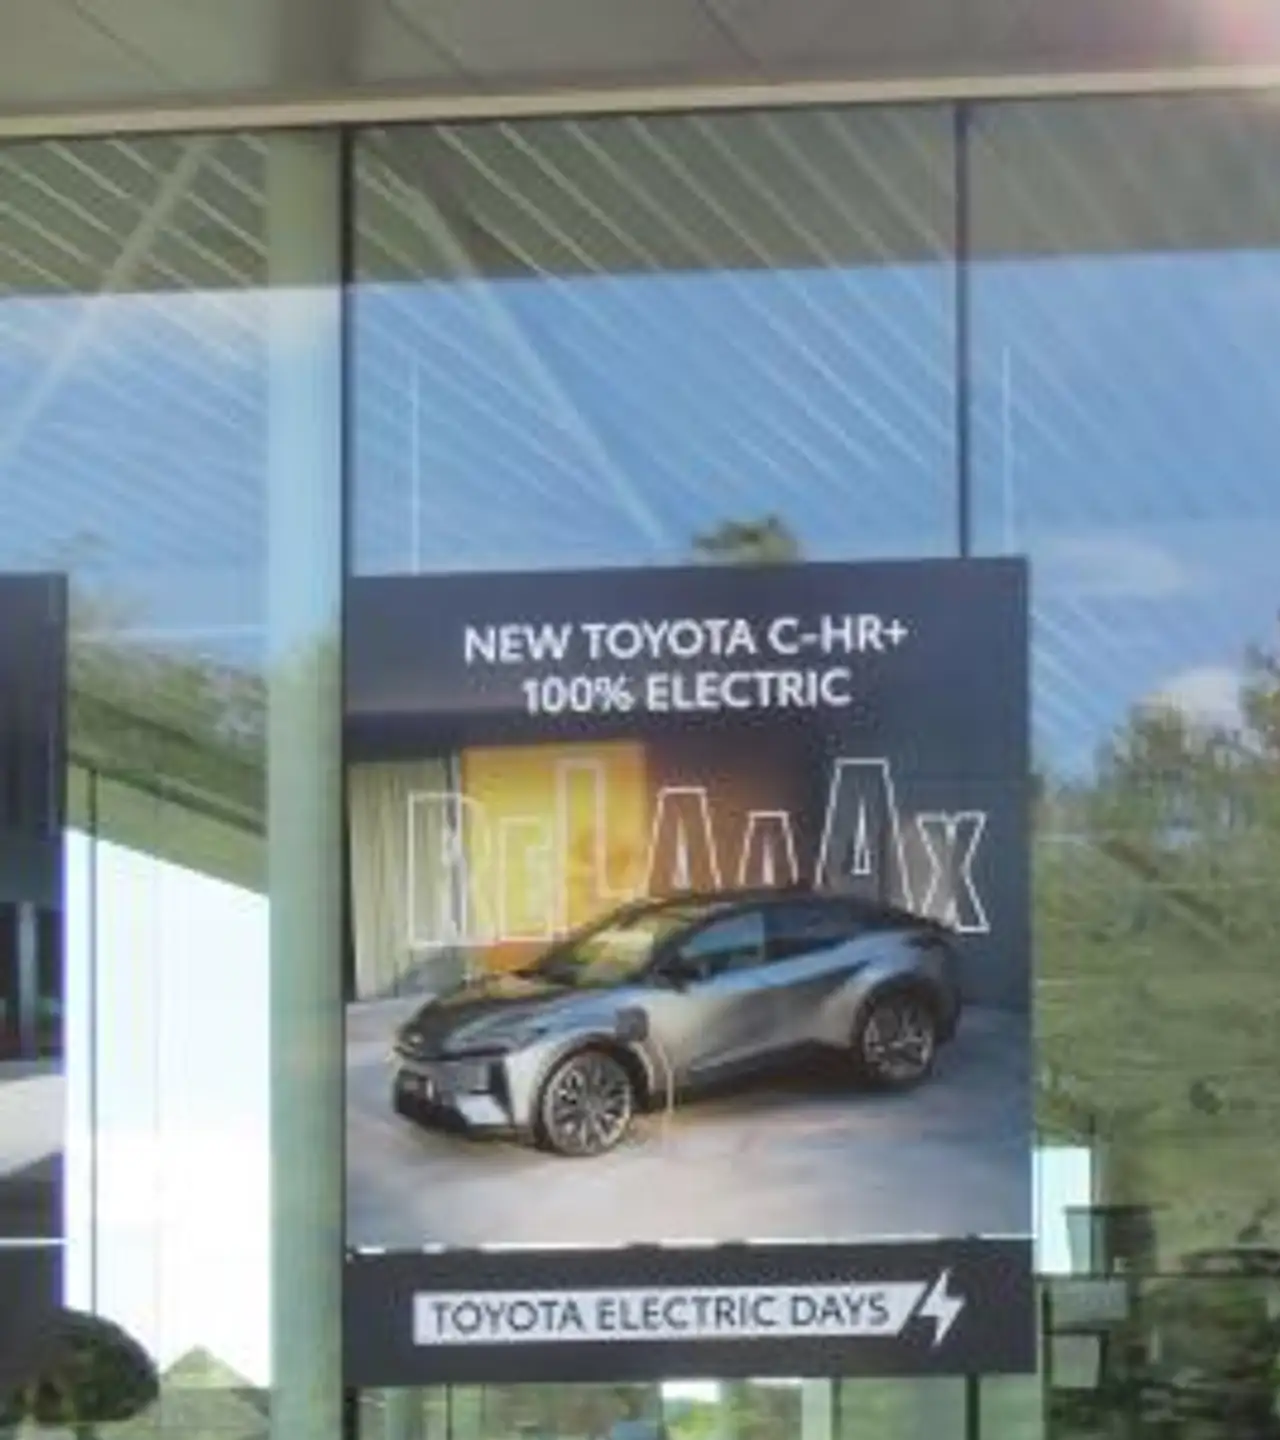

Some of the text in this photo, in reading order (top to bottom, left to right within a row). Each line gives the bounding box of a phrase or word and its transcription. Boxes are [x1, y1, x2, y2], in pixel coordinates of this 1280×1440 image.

[464, 614, 910, 664] NEW TOYOTA C-HR+
[521, 668, 852, 716] 100% ELECTRIC
[433, 1292, 890, 1336] TOYOTA ELECTRIC DAYS
